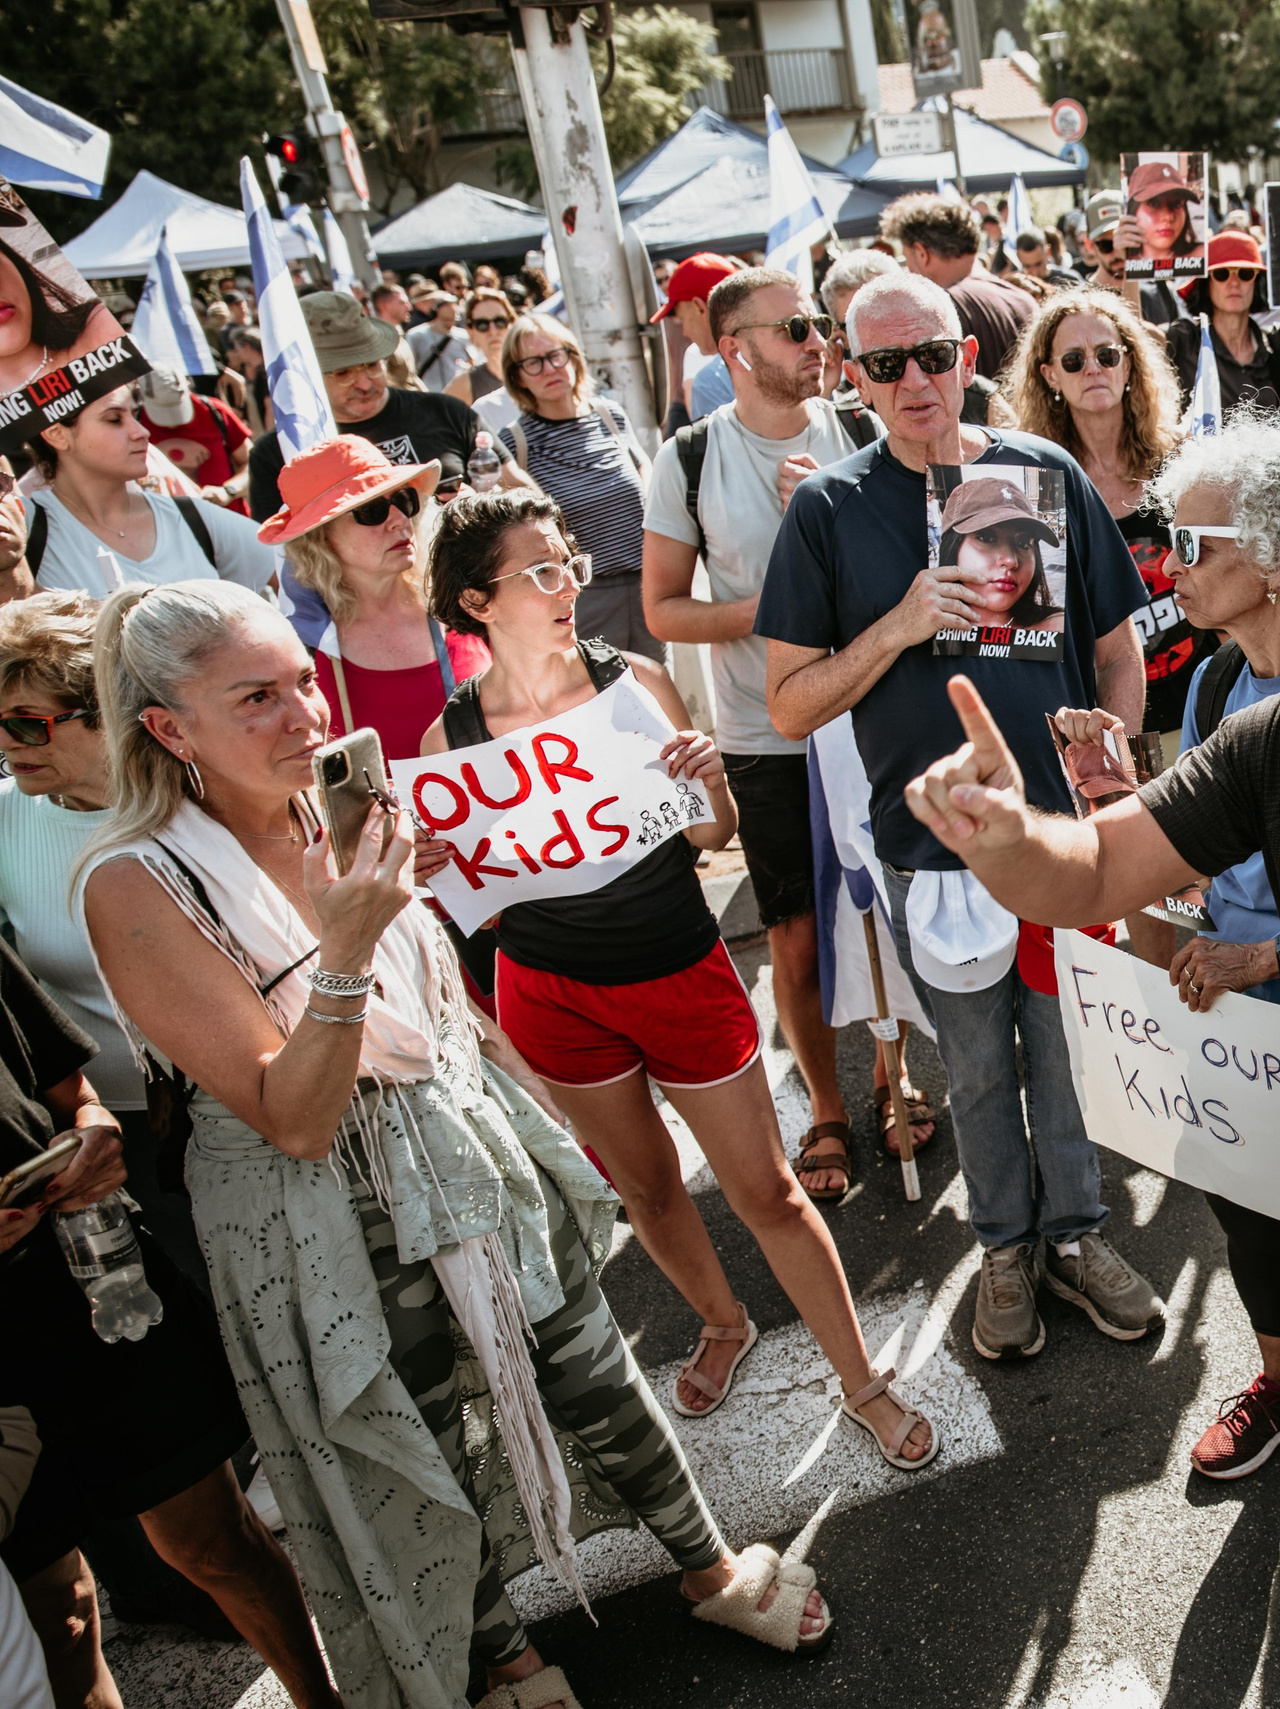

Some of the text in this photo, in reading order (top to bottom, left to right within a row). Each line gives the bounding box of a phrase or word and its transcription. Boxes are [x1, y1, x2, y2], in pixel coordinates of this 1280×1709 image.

[1125, 259, 1154, 272] BRING
[1174, 257, 1203, 269] BACK
[26, 368, 72, 407] LIRI
[68, 337, 132, 384] BACK
[42, 389, 86, 423] NOW!
[978, 644, 1011, 658] NOW!
[980, 626, 1012, 644] LIRI
[1013, 628, 1059, 648] BACK
[412, 732, 594, 831] OUR
[1165, 896, 1205, 920] BACK
[1072, 964, 1175, 1055] Free
